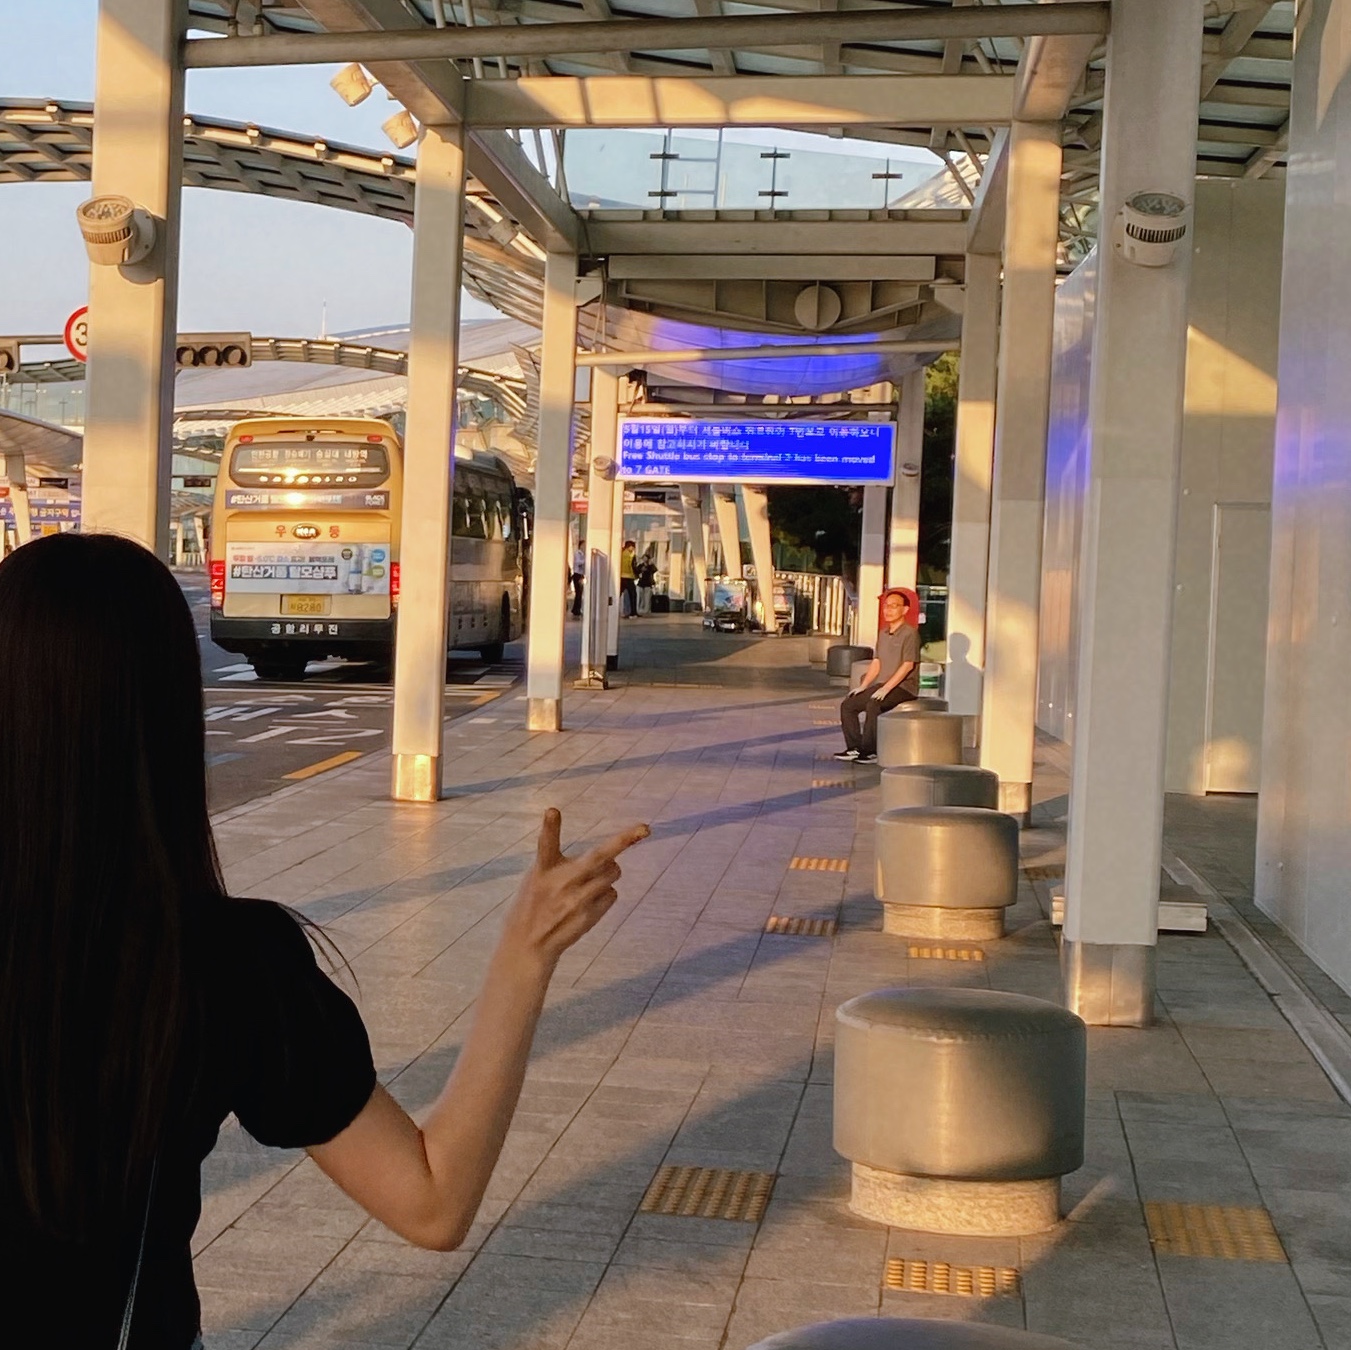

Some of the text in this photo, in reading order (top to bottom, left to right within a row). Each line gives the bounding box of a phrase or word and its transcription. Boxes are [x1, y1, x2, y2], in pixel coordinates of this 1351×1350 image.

[623, 438, 653, 450] 이용에
[623, 451, 643, 460] Free
[646, 451, 680, 460] Shuttle
[683, 452, 700, 460] bus
[703, 452, 725, 463] stop
[814, 454, 838, 462] been
[841, 455, 876, 464] moved
[621, 465, 670, 474] to 7 GATE
[270, 623, 339, 635] 공항리무진
